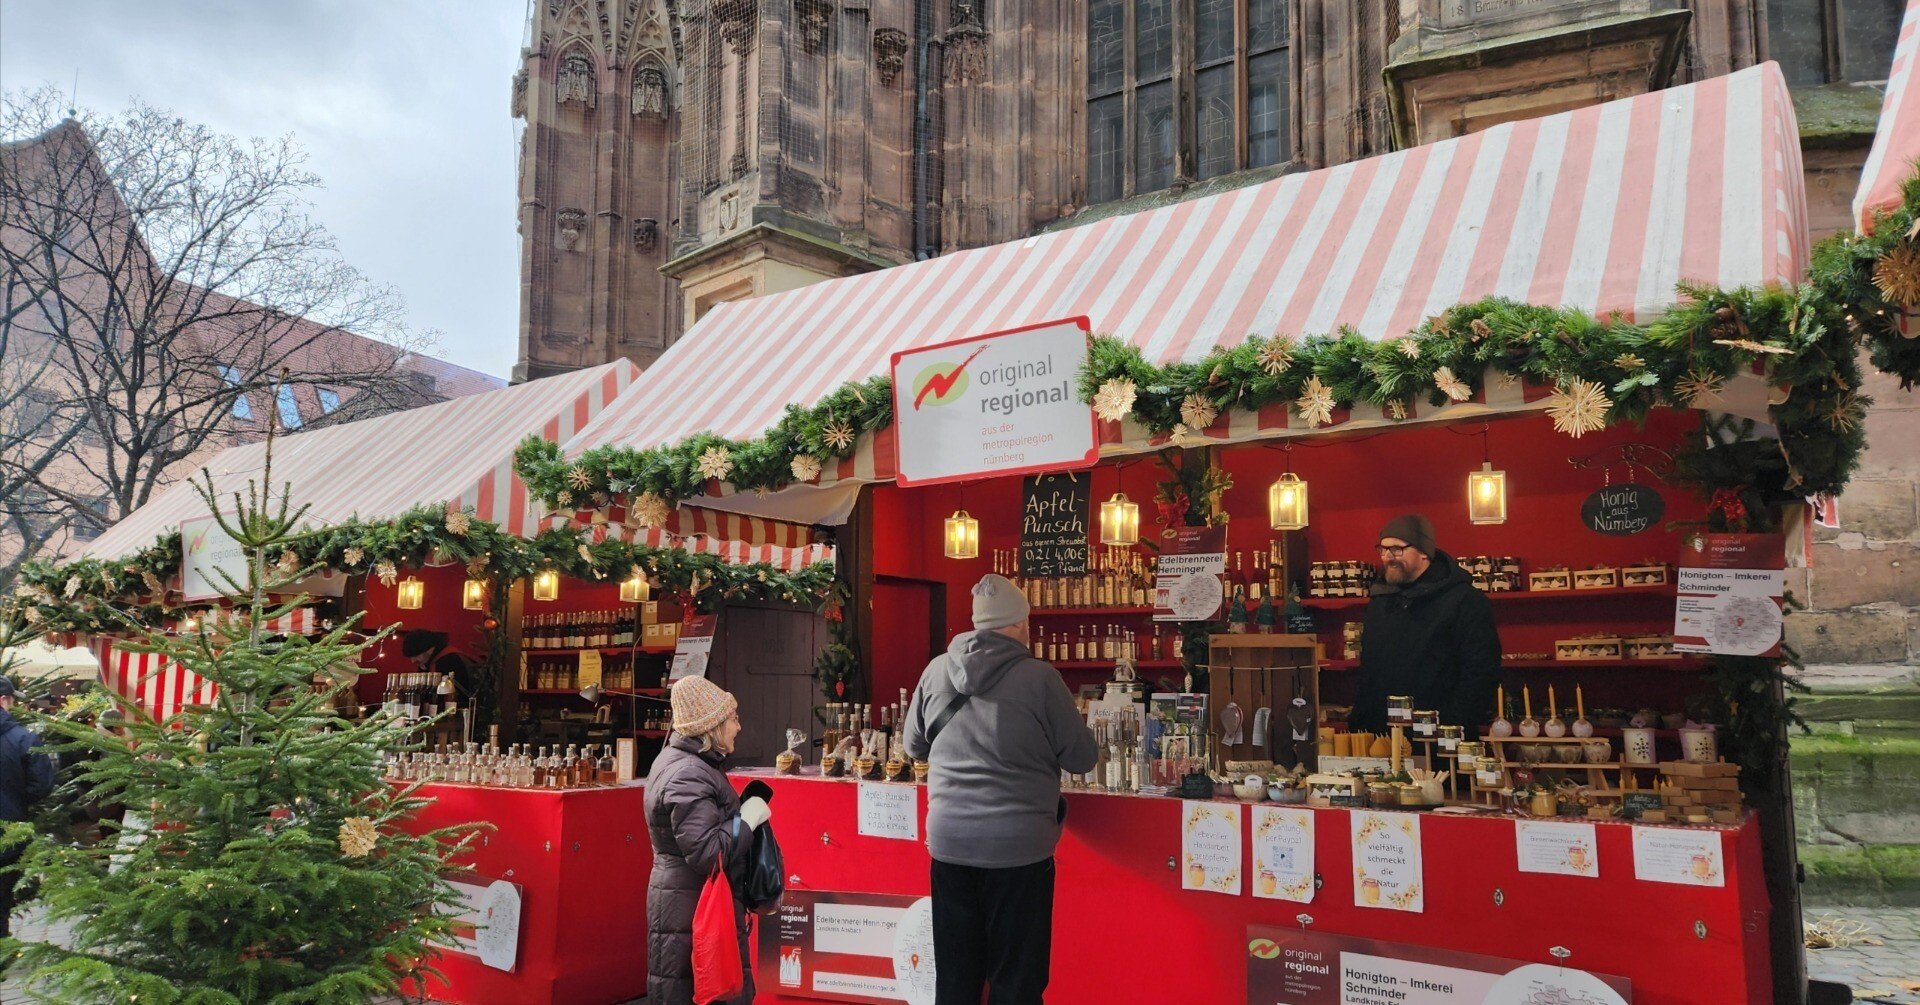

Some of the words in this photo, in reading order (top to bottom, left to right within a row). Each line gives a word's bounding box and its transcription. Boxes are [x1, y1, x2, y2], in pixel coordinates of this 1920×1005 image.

[980, 354, 1052, 386] original
[981, 381, 1069, 415] regional
[982, 425, 997, 436] aus
[999, 422, 1015, 433] der
[982, 432, 1054, 451] metropolregion
[983, 450, 1025, 465] nürnberg
[1026, 490, 1084, 518] Apfel-
[1600, 487, 1639, 510] Honig
[1611, 507, 1629, 516] aus
[1023, 514, 1086, 535] Punsch
[1594, 510, 1648, 534] Nürnberg
[1711, 545, 1746, 555] regional
[1158, 554, 1223, 565] Edelbrennerei
[1057, 561, 1086, 574] Pfand
[1158, 565, 1206, 575] Henninger
[1680, 571, 1724, 581] Honigton
[1735, 572, 1771, 581] Imkerei
[1679, 583, 1731, 592] Schminder
[1380, 832, 1391, 840] So
[1368, 843, 1404, 856] vielfältig
[1367, 855, 1406, 865] schmeckt
[1381, 868, 1395, 876] die
[1376, 880, 1400, 888] Natur
[781, 905, 804, 914] original
[781, 914, 809, 924] regional
[816, 915, 862, 925] Edelbrennerei
[863, 918, 898, 930] Henninger
[1285, 949, 1322, 961] original
[1285, 961, 1329, 975] regional
[1345, 968, 1397, 985] Honigton
[1410, 977, 1454, 994] Imkerei
[1345, 981, 1407, 1000] Schminder
[1345, 994, 1386, 1005] Landkreis
